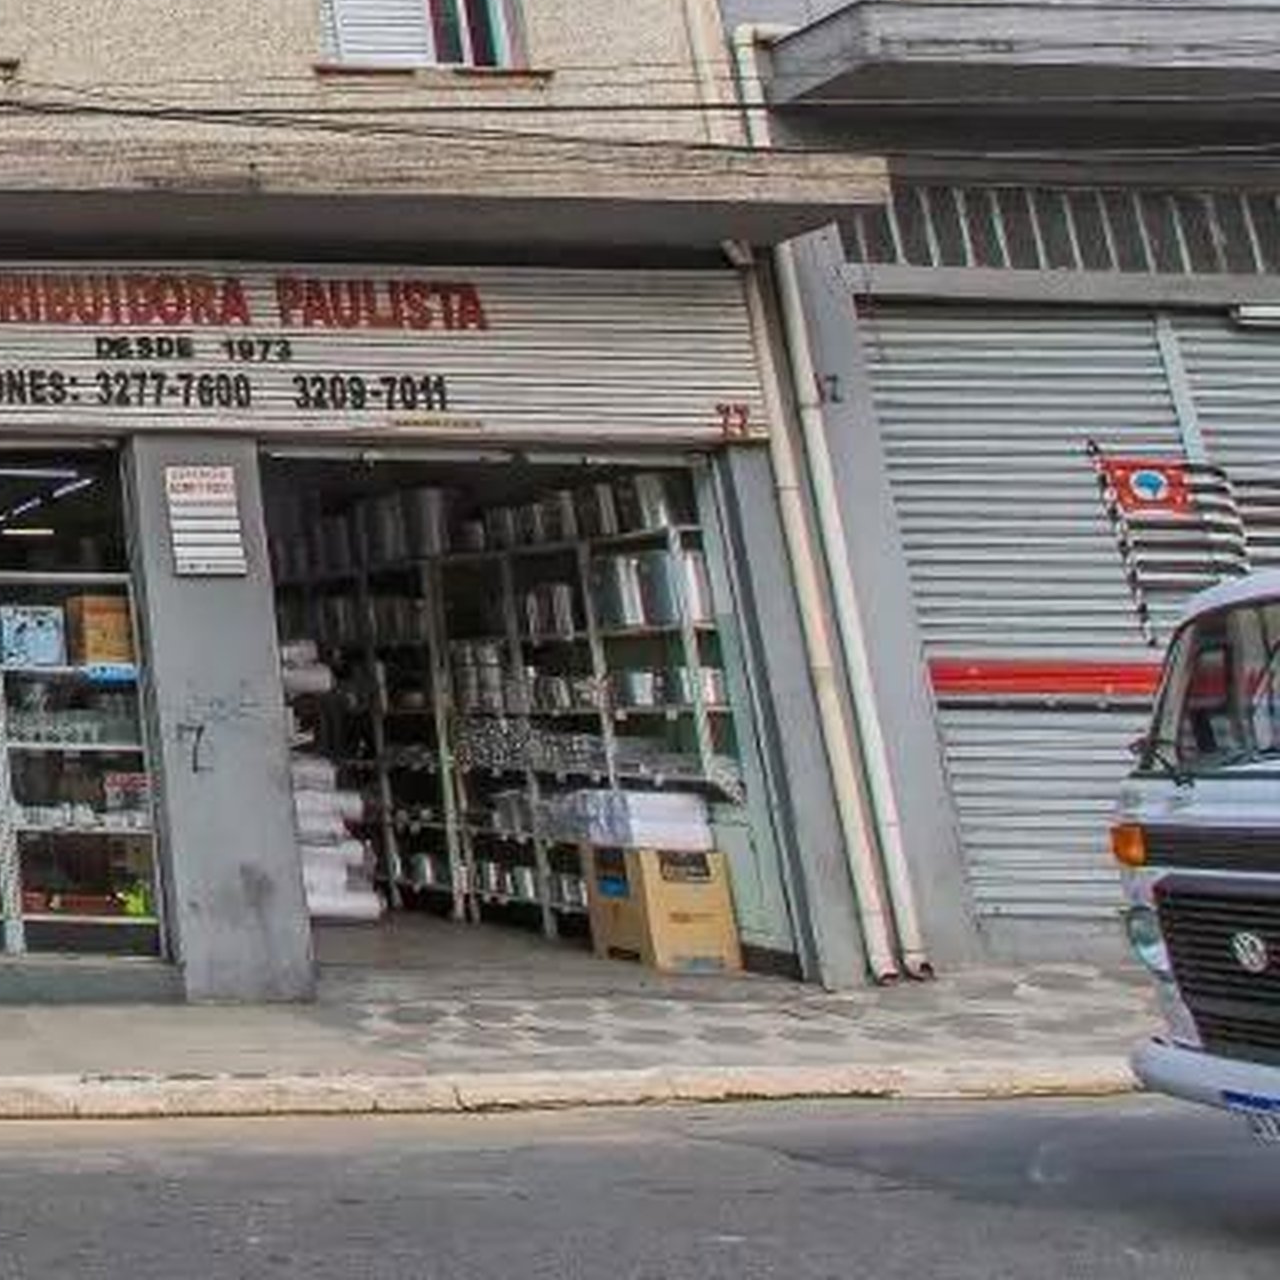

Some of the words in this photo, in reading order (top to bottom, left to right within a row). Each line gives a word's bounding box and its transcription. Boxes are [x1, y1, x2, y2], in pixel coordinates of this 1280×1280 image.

[277, 277, 489, 330] PAULISTA
[96, 336, 193, 359] DESDE
[223, 338, 291, 362] 1973
[95, 373, 251, 408] 3277-7600
[292, 375, 447, 410] 3209-7011
